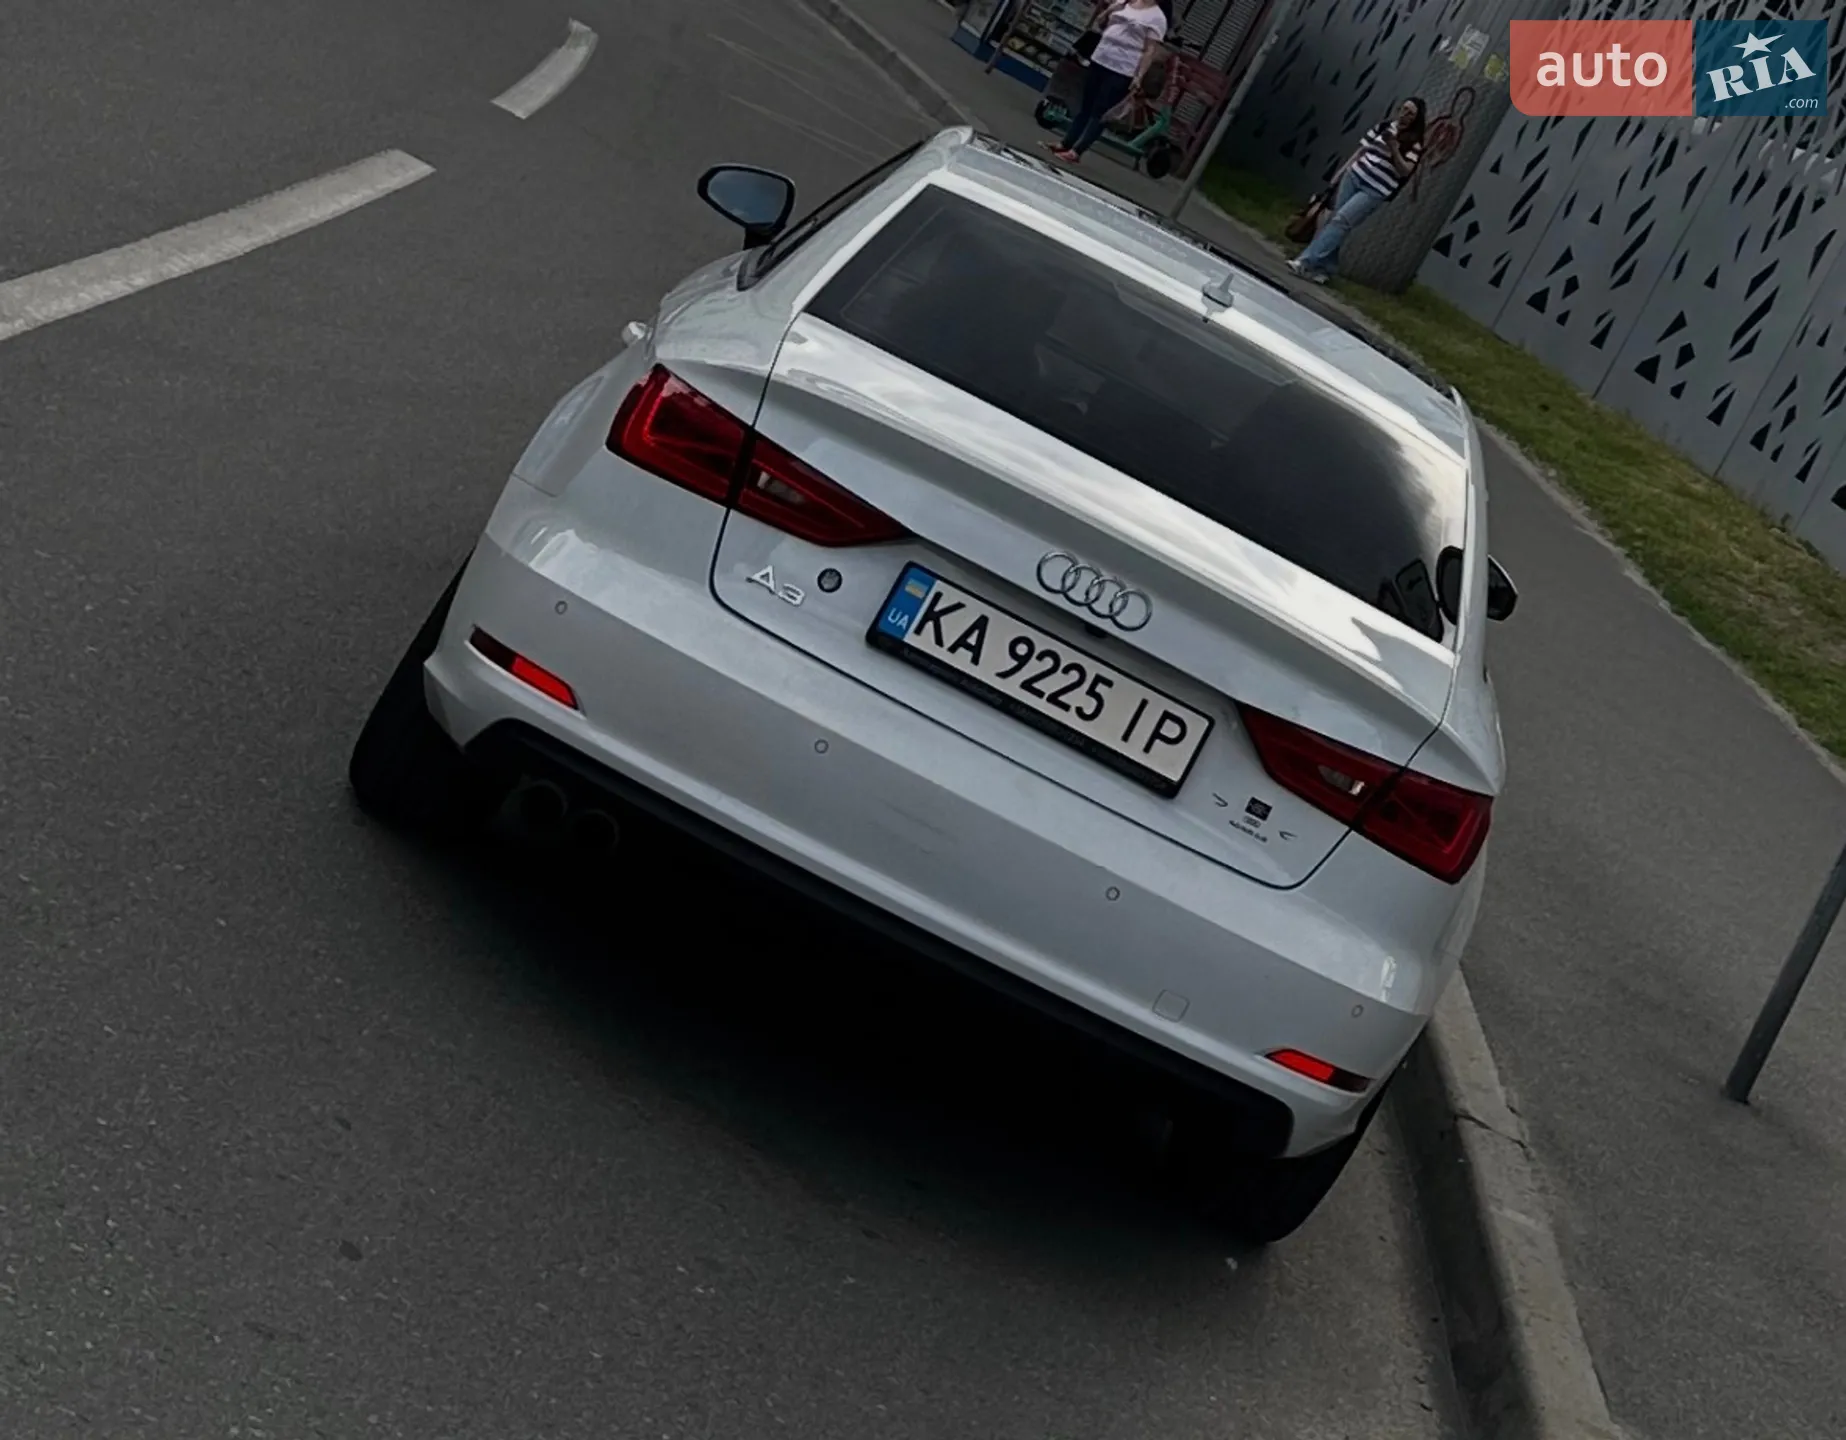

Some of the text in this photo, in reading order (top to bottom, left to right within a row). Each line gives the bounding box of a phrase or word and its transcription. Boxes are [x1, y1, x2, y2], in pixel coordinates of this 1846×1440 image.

[746, 565, 805, 607] A3
[887, 606, 910, 631] UA
[913, 590, 990, 666] KA
[995, 635, 1115, 722] 9225
[1120, 697, 1188, 754] IP
